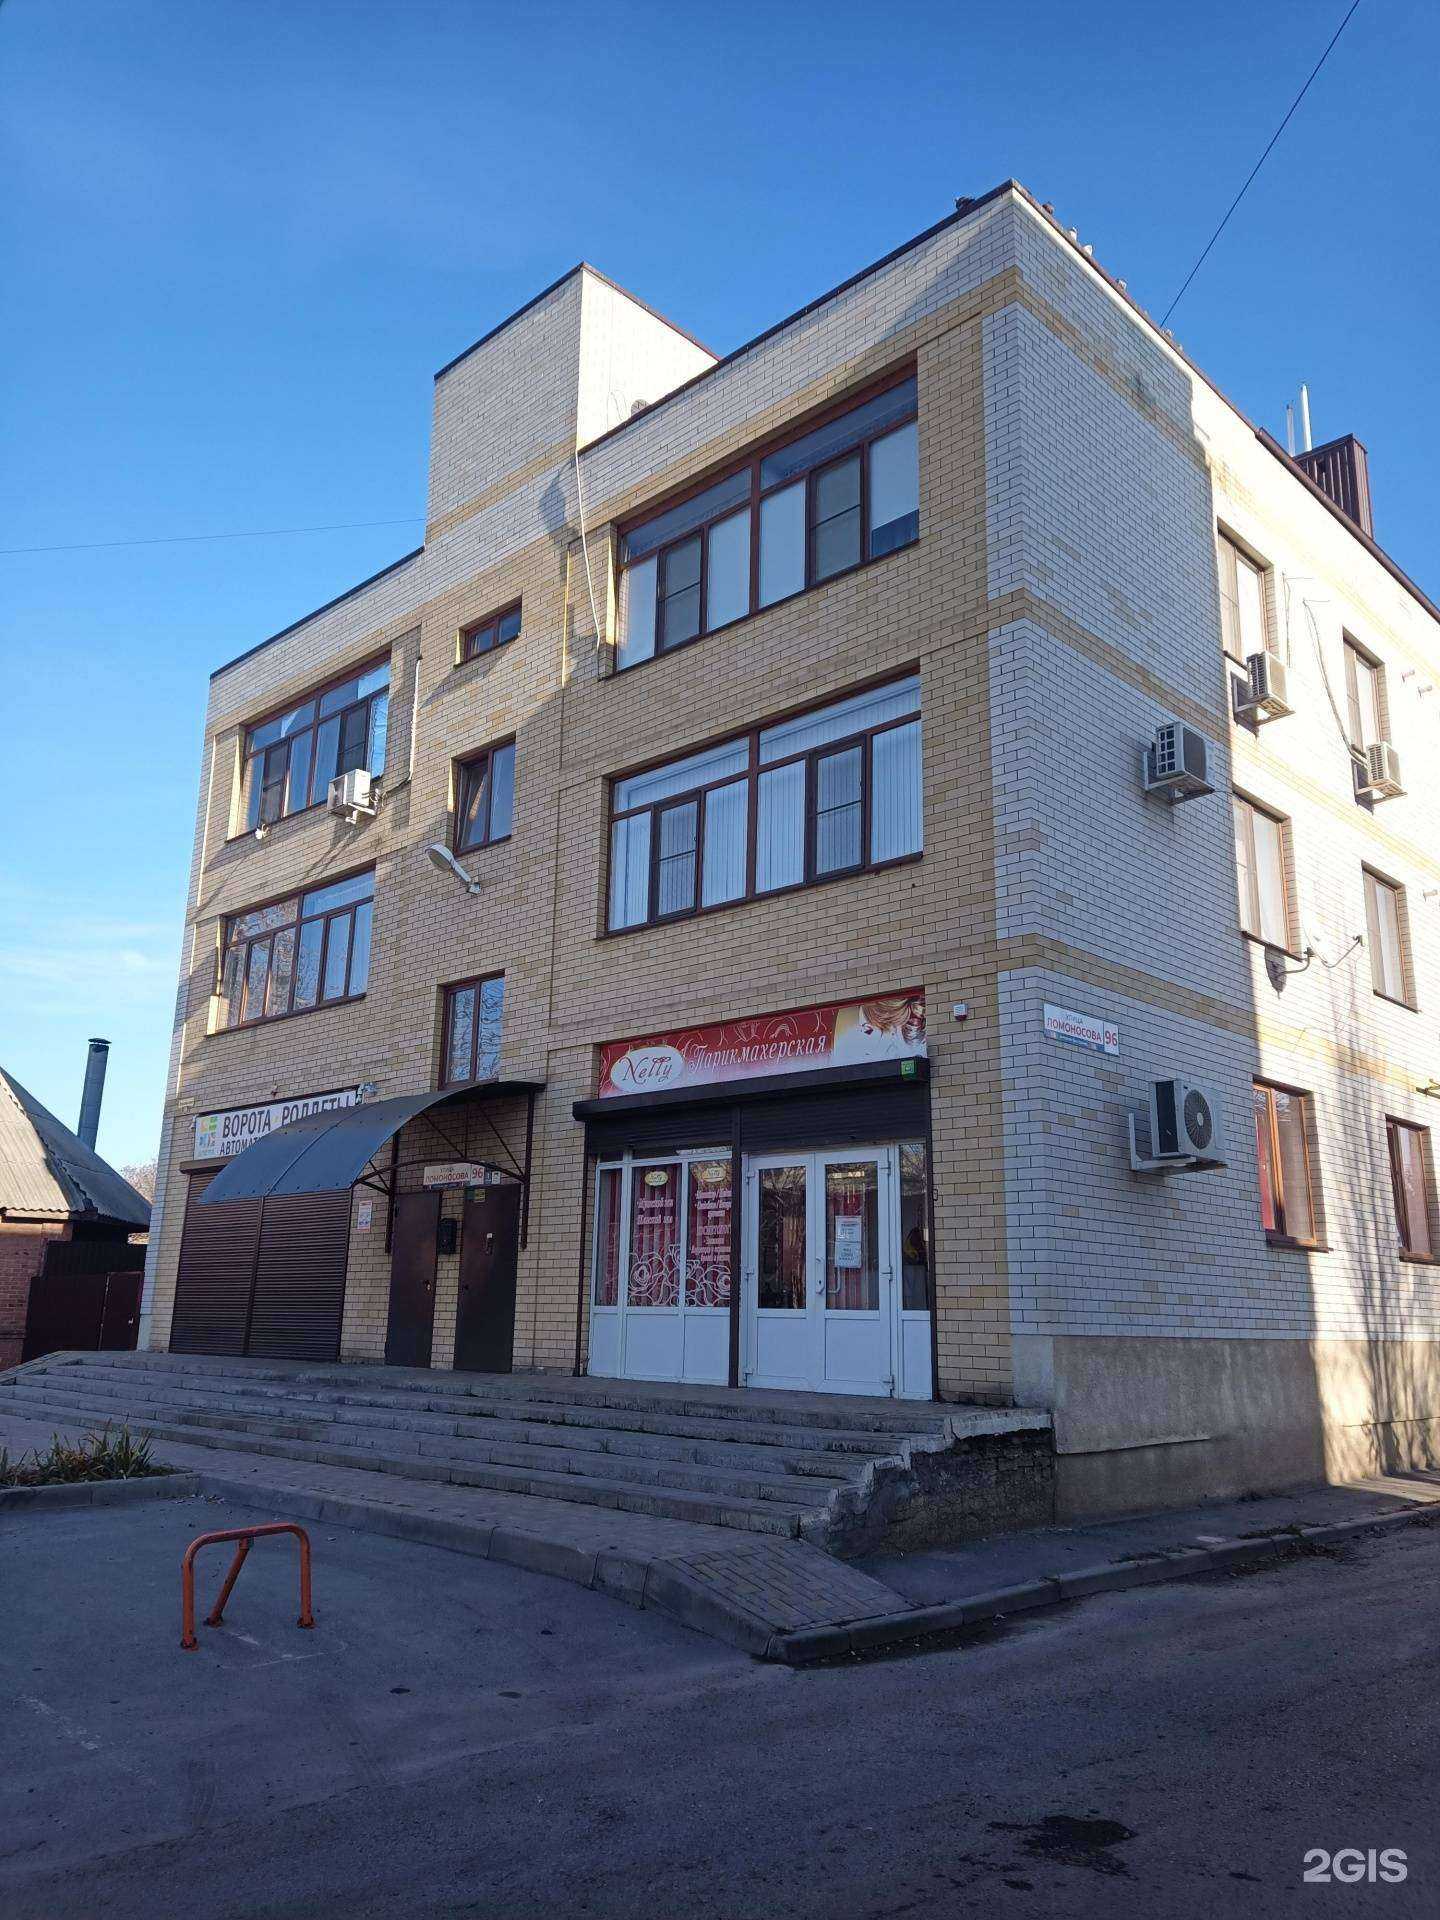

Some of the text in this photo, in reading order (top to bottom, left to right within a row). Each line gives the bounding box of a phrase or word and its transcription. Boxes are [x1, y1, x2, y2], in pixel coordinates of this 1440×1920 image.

[1047, 1017, 1103, 1042] ЛОМОНОСОВА
[1104, 1030, 1118, 1047] 96
[1065, 1013, 1084, 1025] УЛИЦА
[689, 1034, 828, 1073] Парикмахерская
[620, 1056, 672, 1085] Nelly
[222, 1109, 271, 1138] ВОРОТА
[426, 1173, 469, 1182] ЛОМОНОСОВА
[472, 1168, 484, 1178] 96
